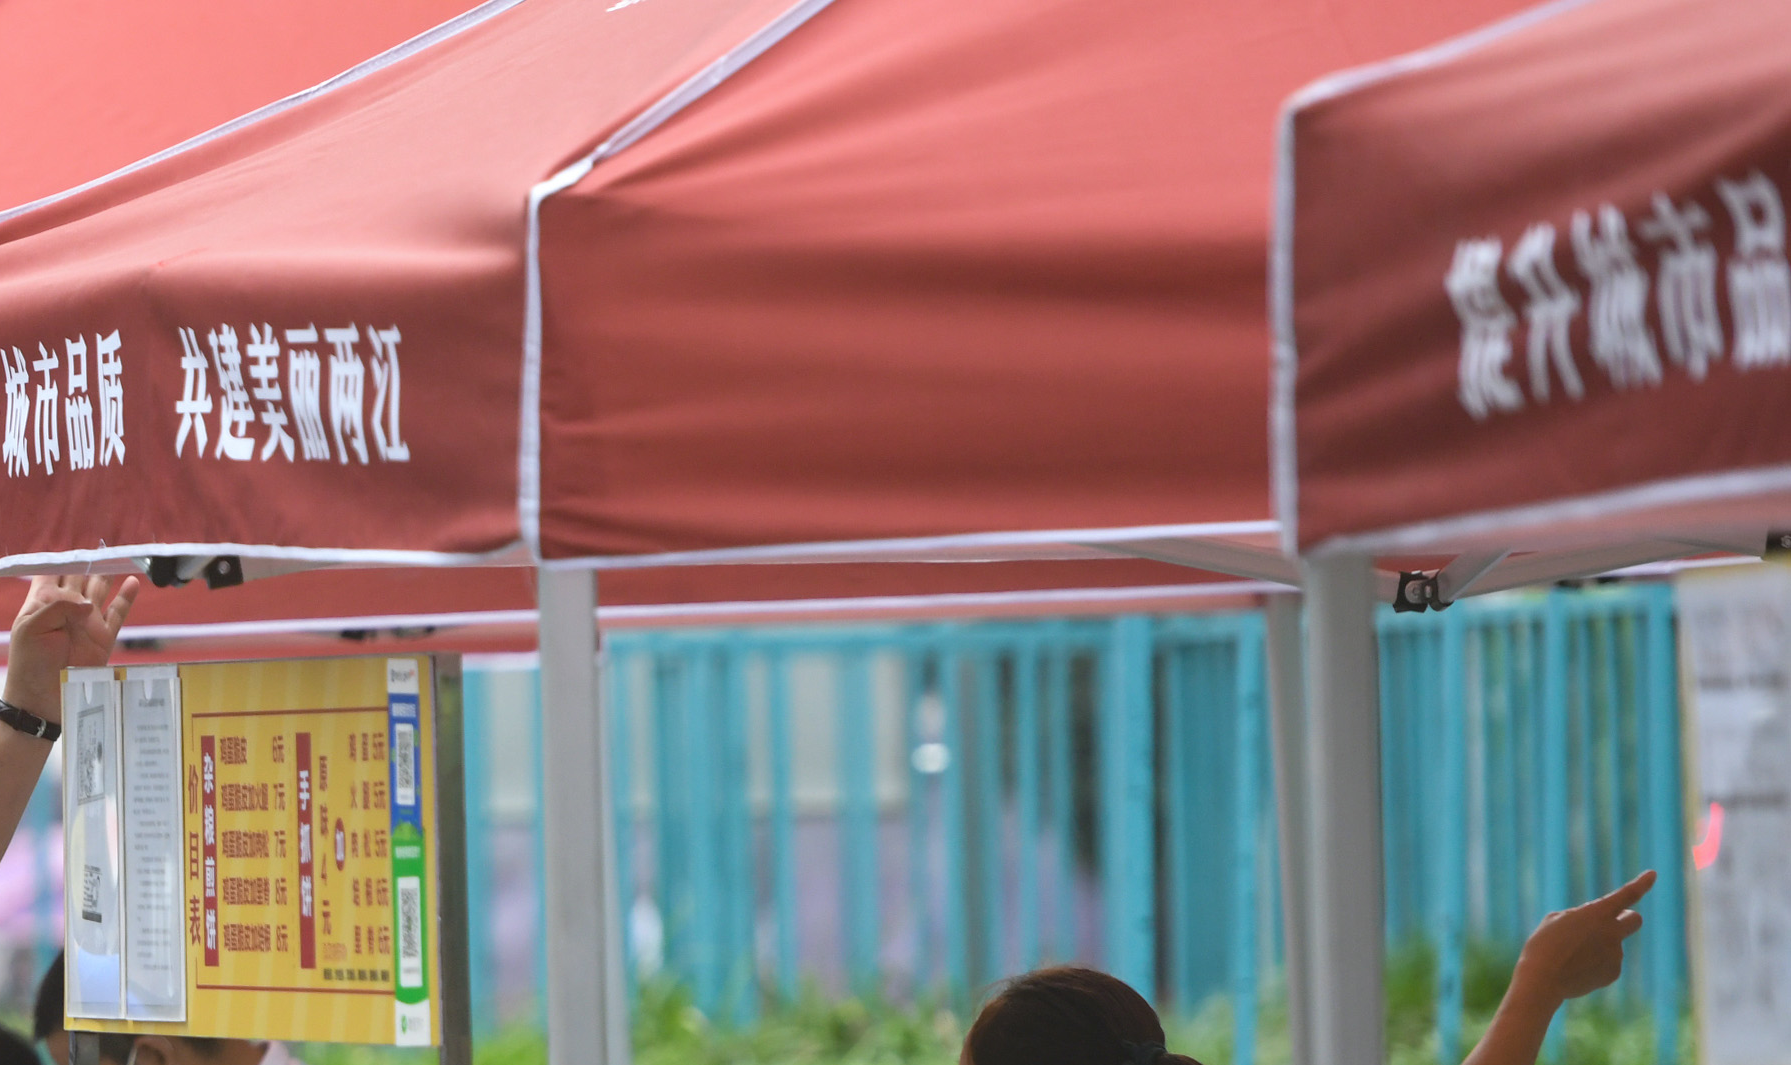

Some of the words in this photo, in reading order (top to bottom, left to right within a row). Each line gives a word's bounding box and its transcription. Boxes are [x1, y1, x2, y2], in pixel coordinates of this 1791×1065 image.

[173, 321, 411, 466] 共建美丽两江
[188, 764, 201, 946] 价目表
[203, 753, 216, 950] 杂粮煎饼
[299, 769, 312, 917] 手抓饼
